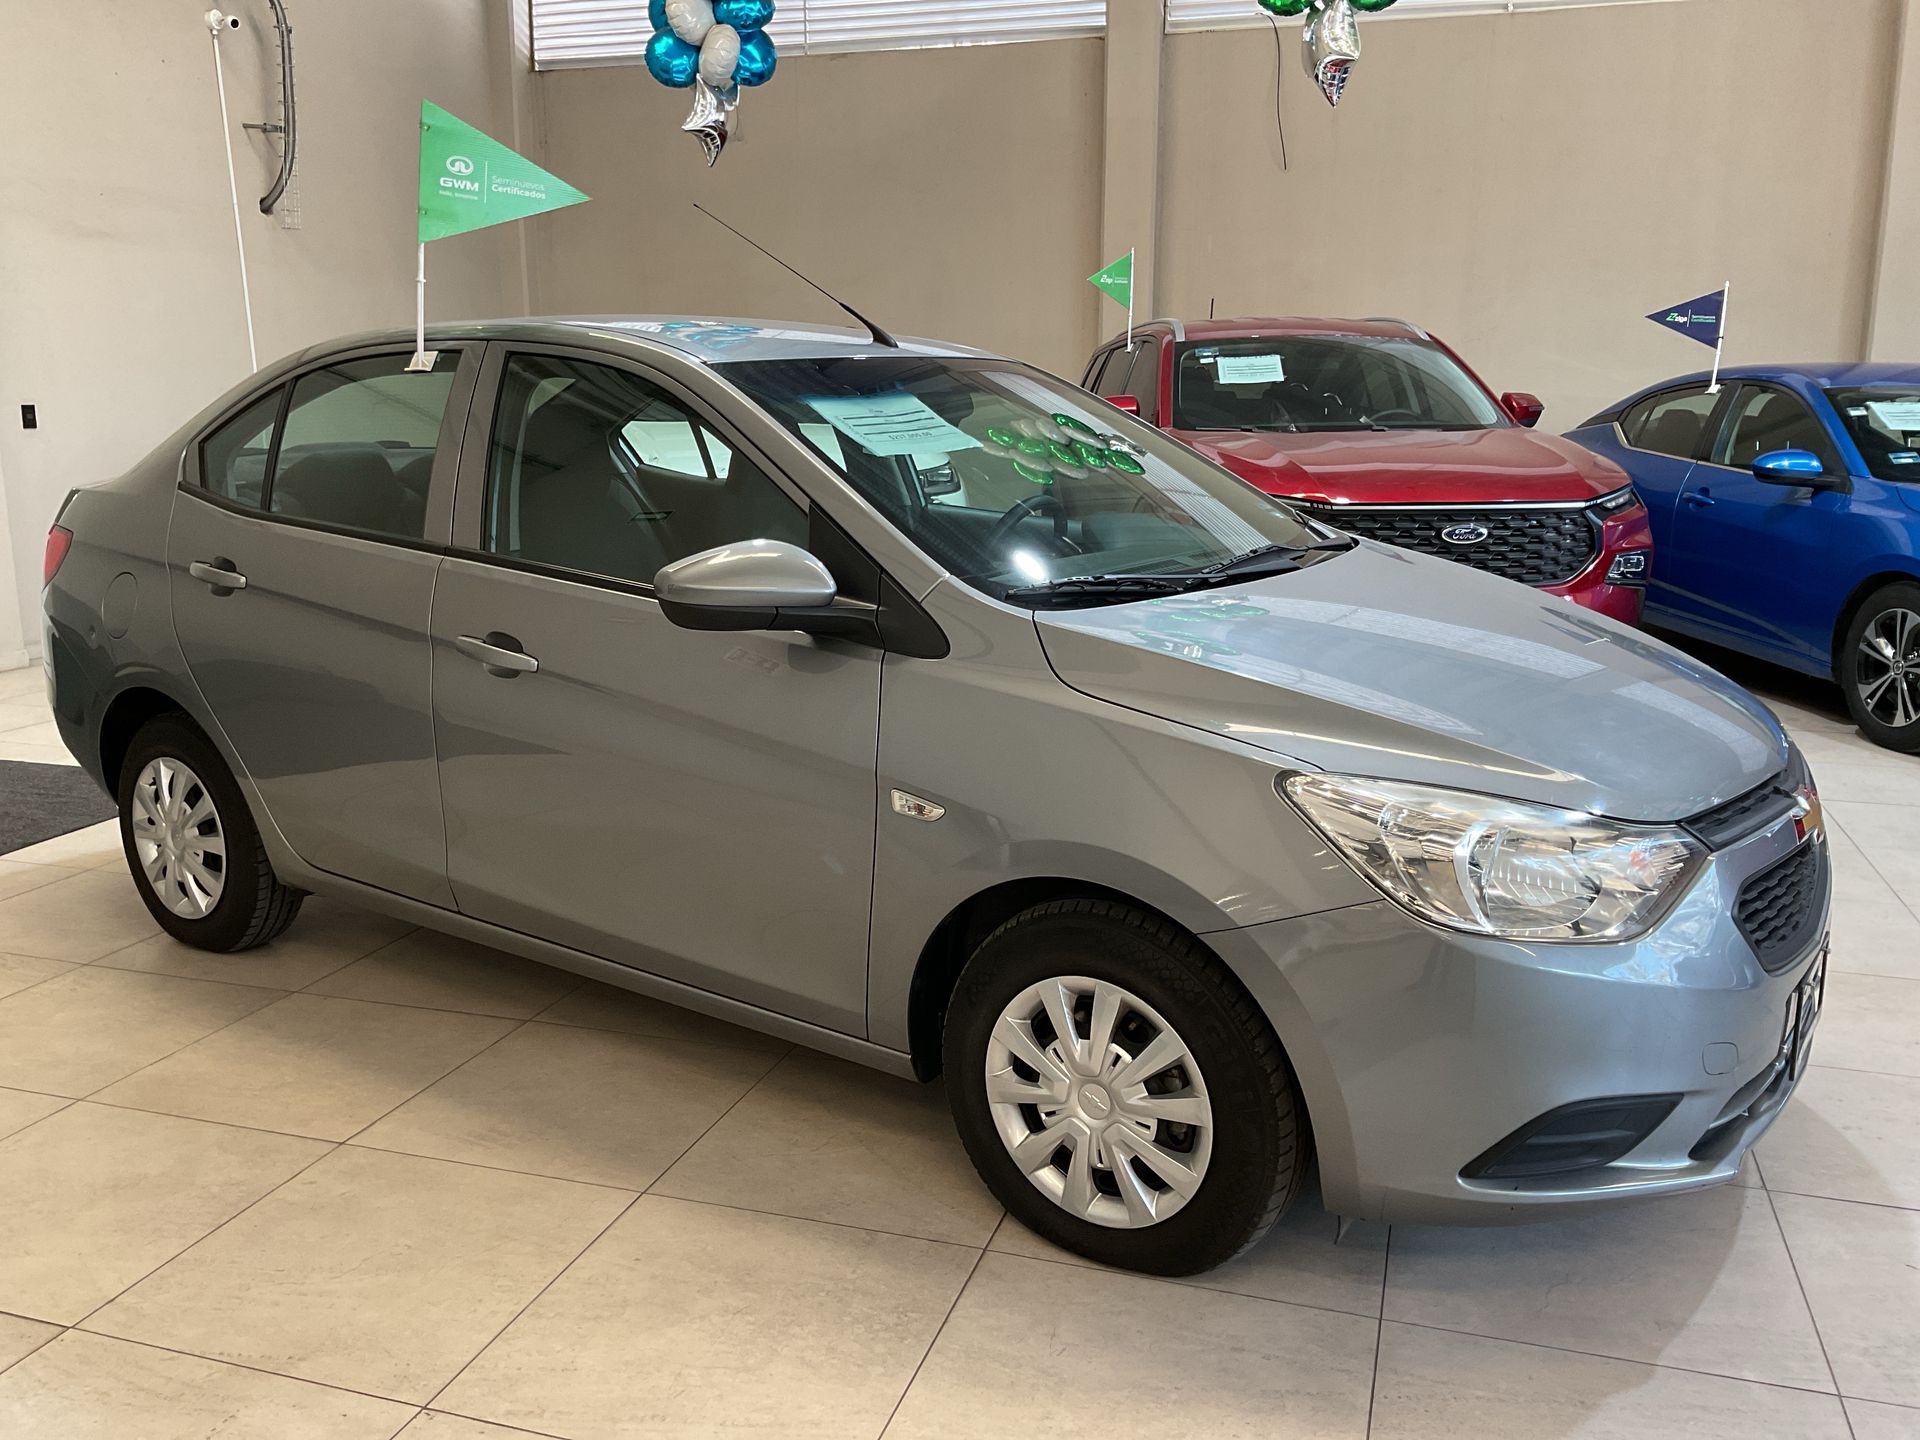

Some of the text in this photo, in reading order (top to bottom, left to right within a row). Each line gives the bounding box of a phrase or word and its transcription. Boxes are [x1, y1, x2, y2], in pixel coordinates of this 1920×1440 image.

[440, 177, 479, 192] GWM
[491, 175, 545, 191] Seminuevos
[491, 184, 546, 200] Certificados
[1452, 528, 1477, 540] Ford
